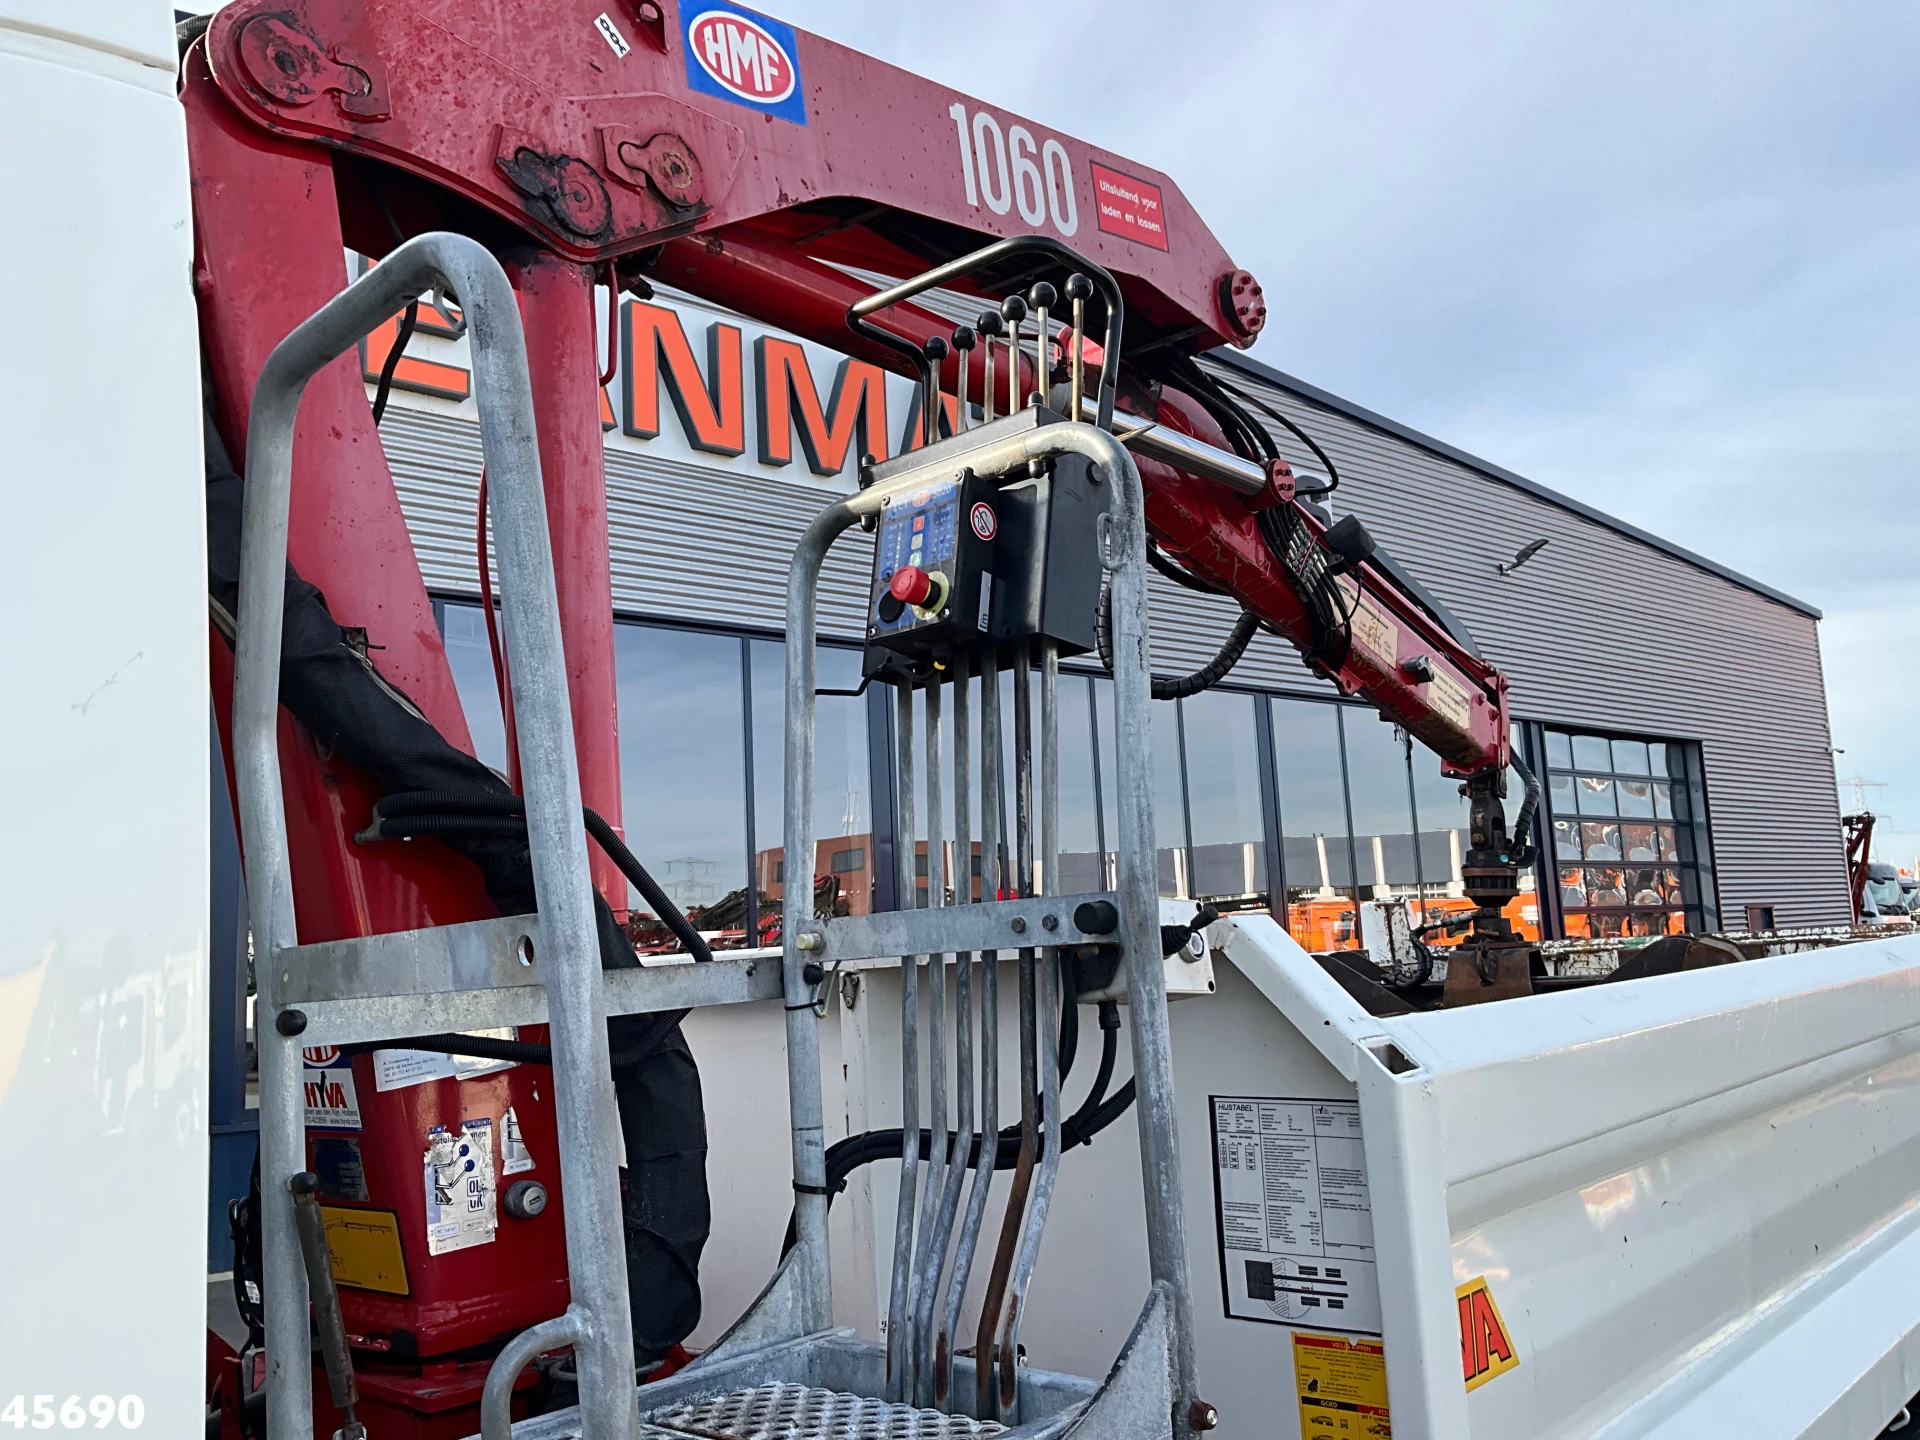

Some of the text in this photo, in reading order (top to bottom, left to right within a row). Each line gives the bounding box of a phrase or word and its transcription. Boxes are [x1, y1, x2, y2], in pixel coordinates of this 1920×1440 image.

[703, 23, 781, 92] HMF
[949, 103, 1077, 237] 1060
[1099, 180, 1157, 209] Uitsluitend voor
[1101, 203, 1121, 219] laden
[1125, 213, 1134, 223] en
[304, 1070, 348, 1108] HYVA
[1218, 1104, 1253, 1112] HIJSTABEL
[1321, 1400, 1337, 1408] GOED
